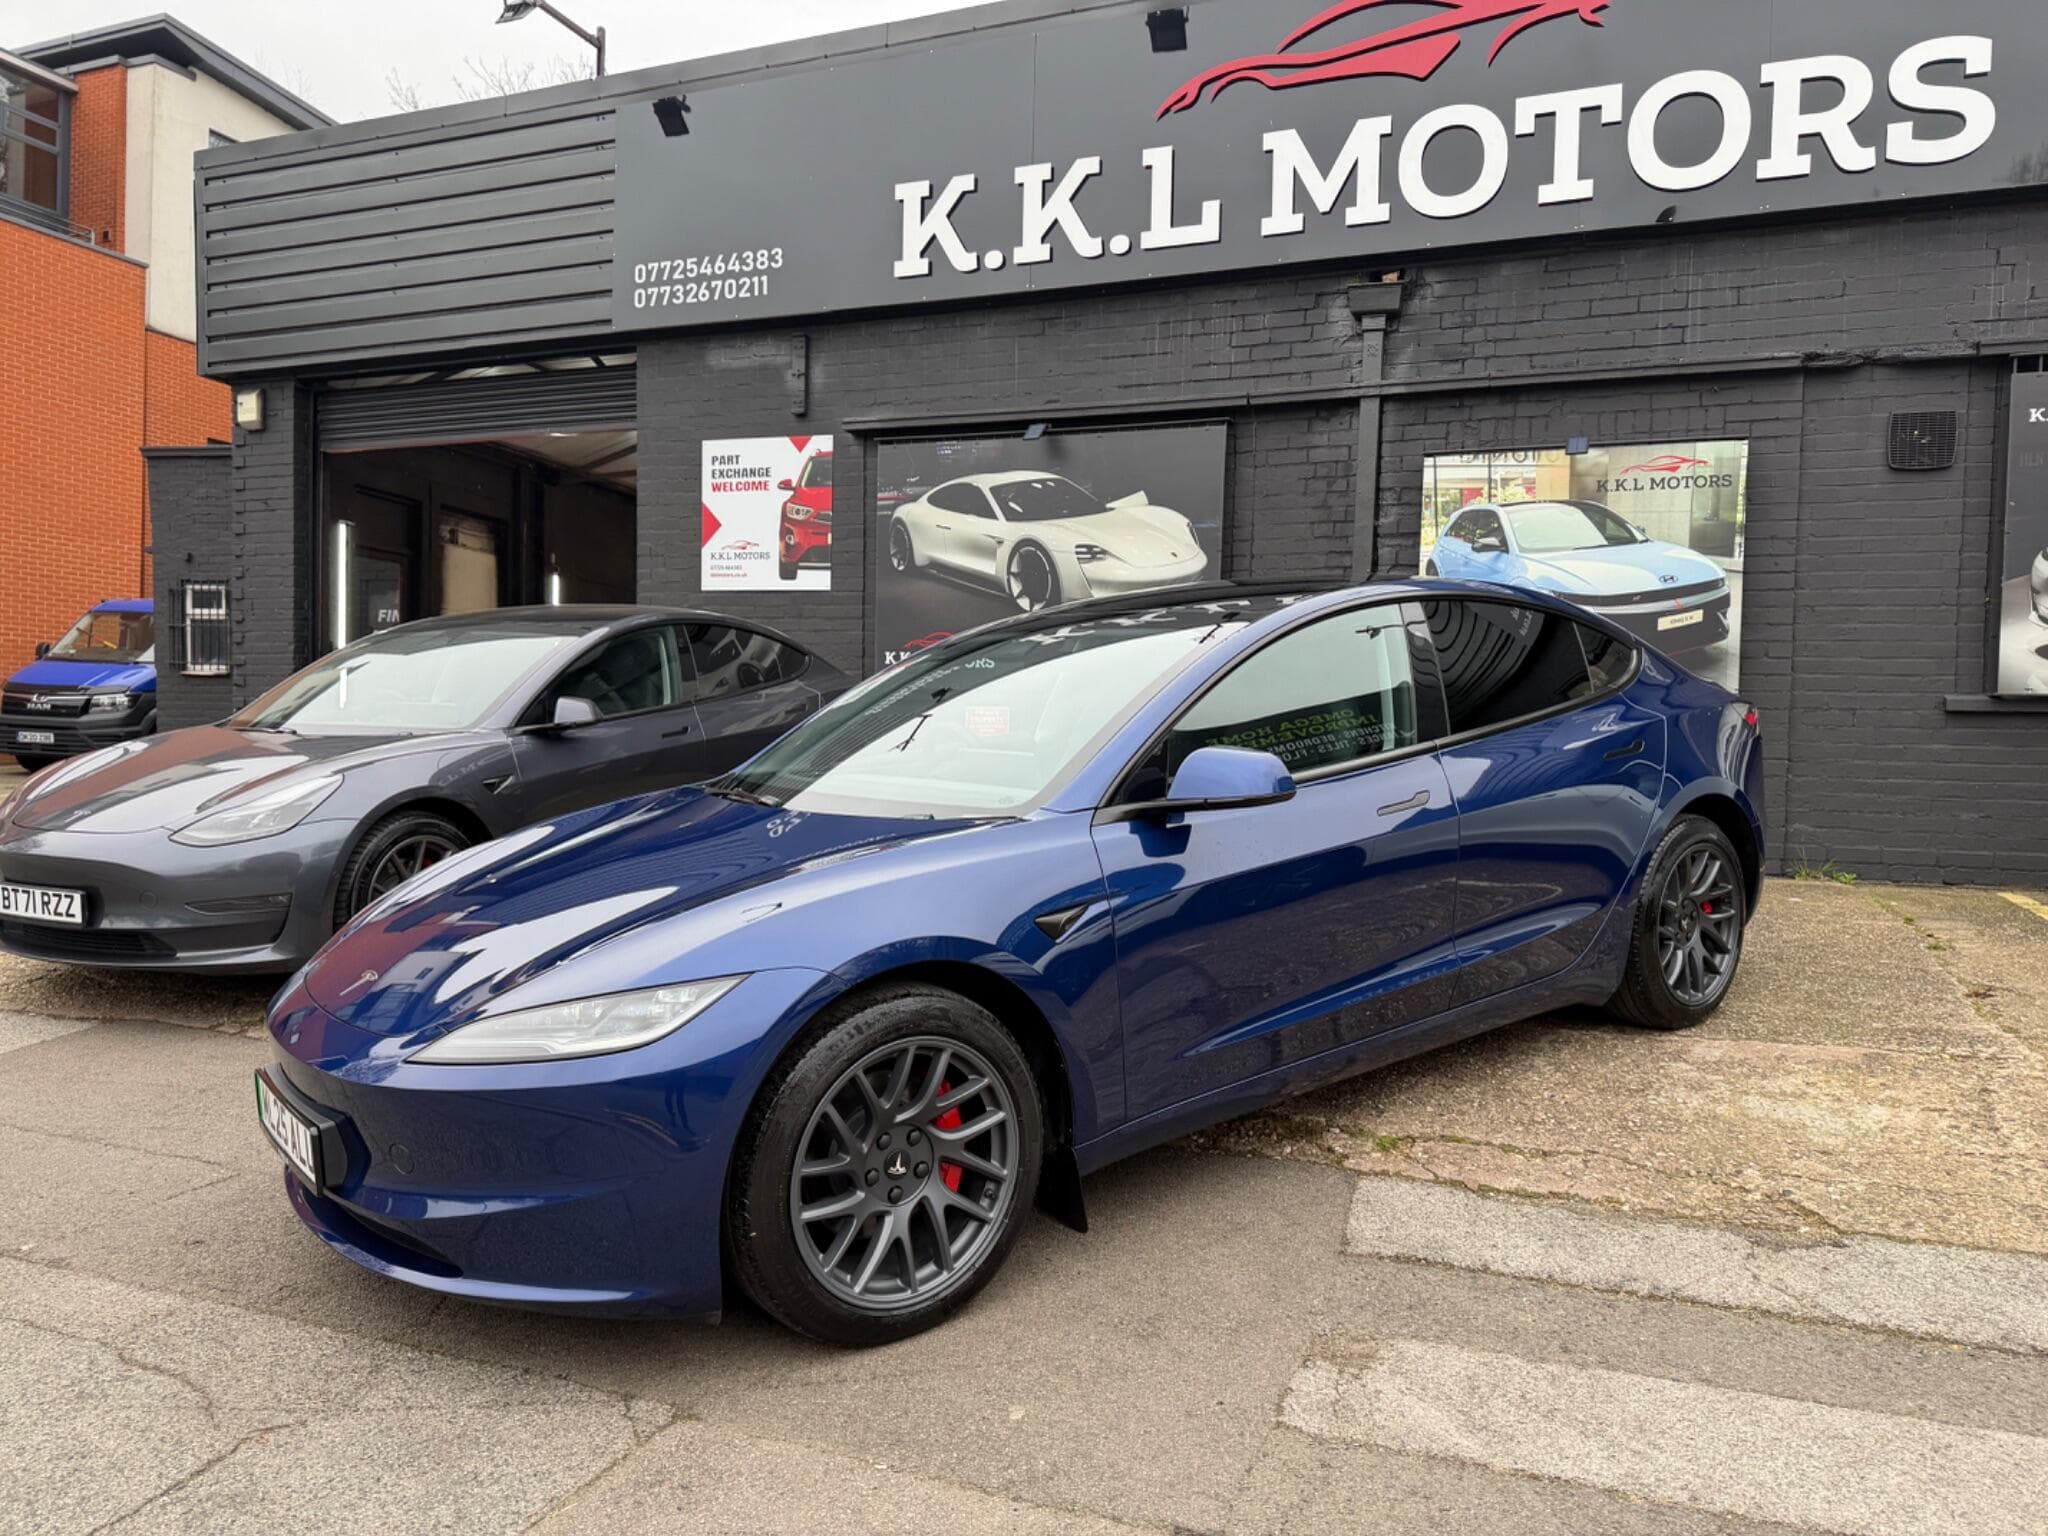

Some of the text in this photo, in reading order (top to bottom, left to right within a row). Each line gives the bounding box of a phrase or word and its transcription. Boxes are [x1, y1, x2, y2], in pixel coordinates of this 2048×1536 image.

[893, 35, 1996, 278] K.K.L MOTORS
[634, 248, 783, 283] 07725464383
[634, 275, 768, 308] 07732670211
[711, 455, 741, 466] PART
[711, 467, 772, 480] EXCHANGE
[711, 480, 770, 493] WELCOME
[1596, 474, 1733, 493] K.K.L MOTORS
[733, 551, 771, 560] MOTORS
[1, 887, 76, 918] BT71 RZZ
